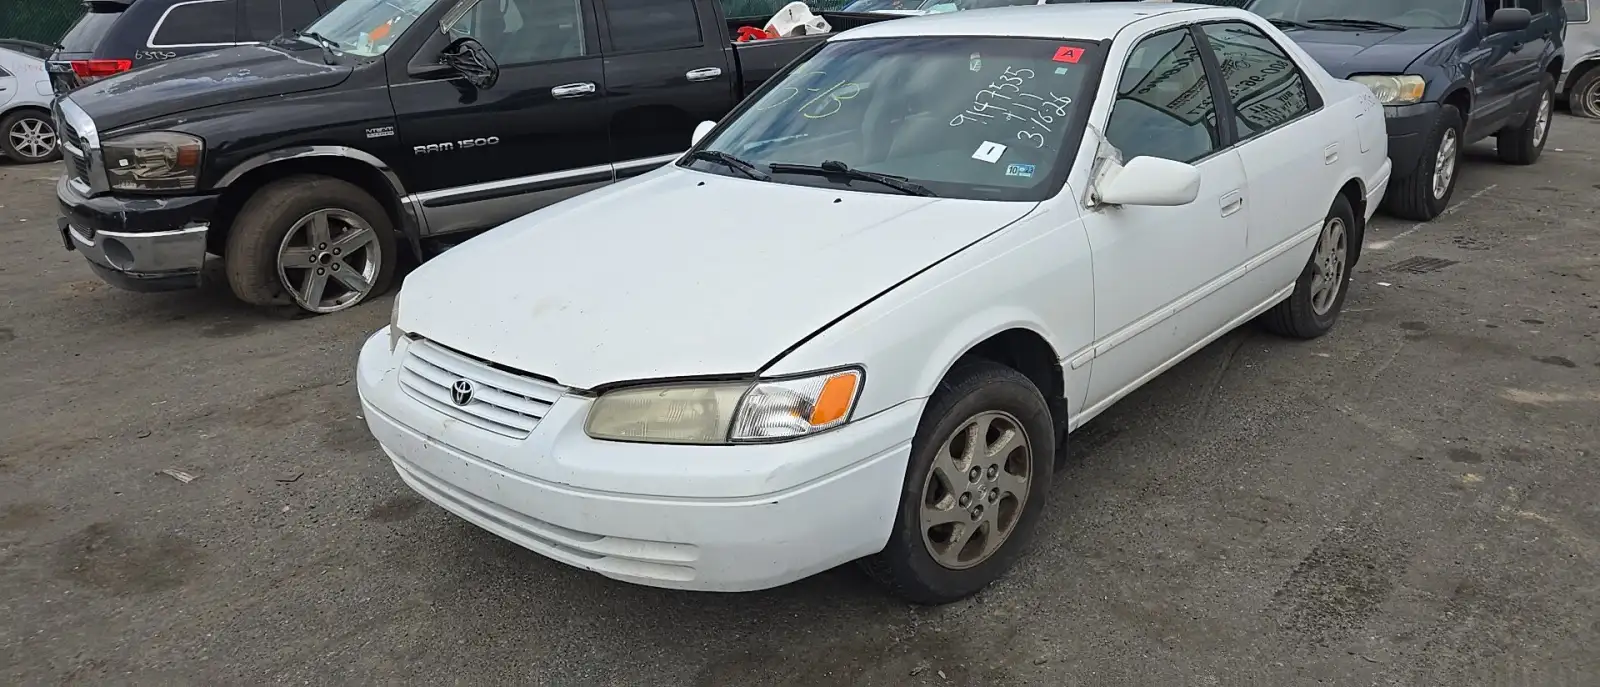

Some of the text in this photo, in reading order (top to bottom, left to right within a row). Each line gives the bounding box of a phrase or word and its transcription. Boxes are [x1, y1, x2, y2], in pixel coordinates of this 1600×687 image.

[1061, 49, 1074, 58] A
[949, 65, 1035, 127] 9147535
[413, 136, 500, 155] RAM 1500
[1008, 166, 1018, 174] 10
